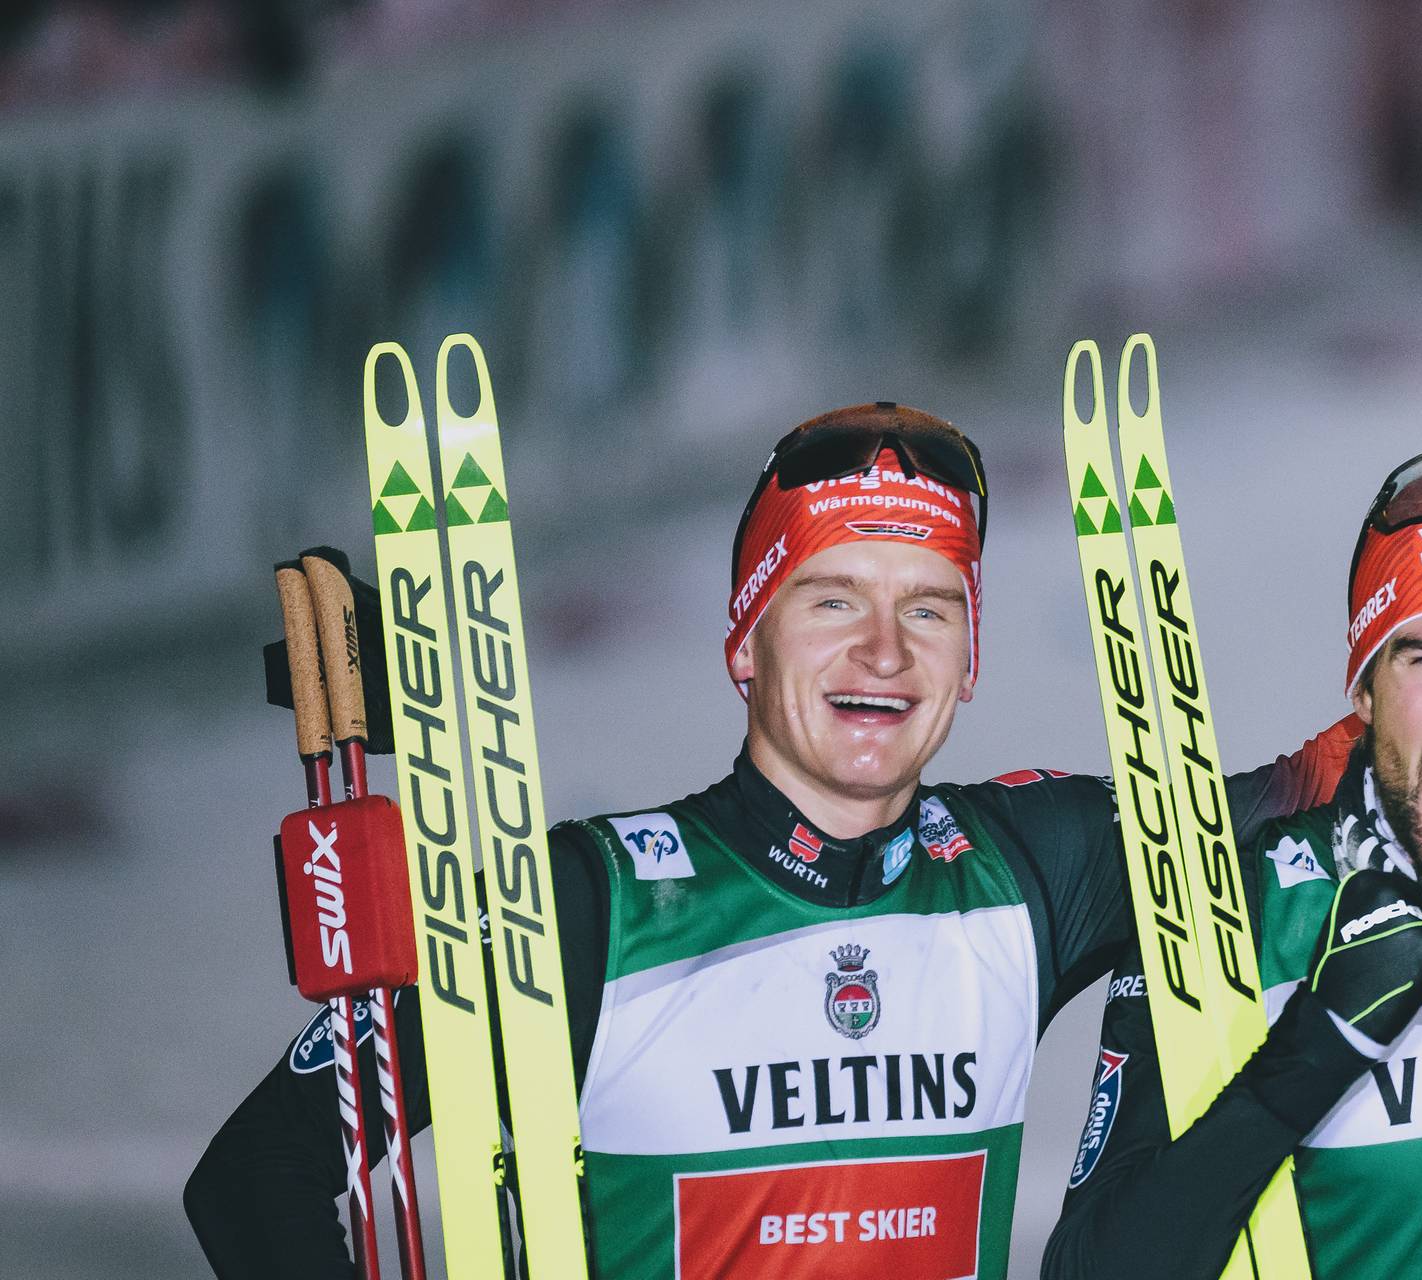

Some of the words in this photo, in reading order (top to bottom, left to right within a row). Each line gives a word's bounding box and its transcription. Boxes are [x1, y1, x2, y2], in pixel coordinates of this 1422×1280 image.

[809, 493, 961, 528] Wärmepumpen
[733, 533, 789, 621] TERREX
[1349, 577, 1398, 648] TERREX
[390, 567, 476, 1015] FISCHER
[462, 560, 554, 1007] FISCHER
[1095, 568, 1202, 1012] FISCHER
[1150, 559, 1257, 1003] FISCHER
[767, 845, 829, 889] WÜRTH
[712, 1051, 977, 1134] VELTINS
[760, 1211, 850, 1245] BEST
[858, 1206, 937, 1241] SKIER
